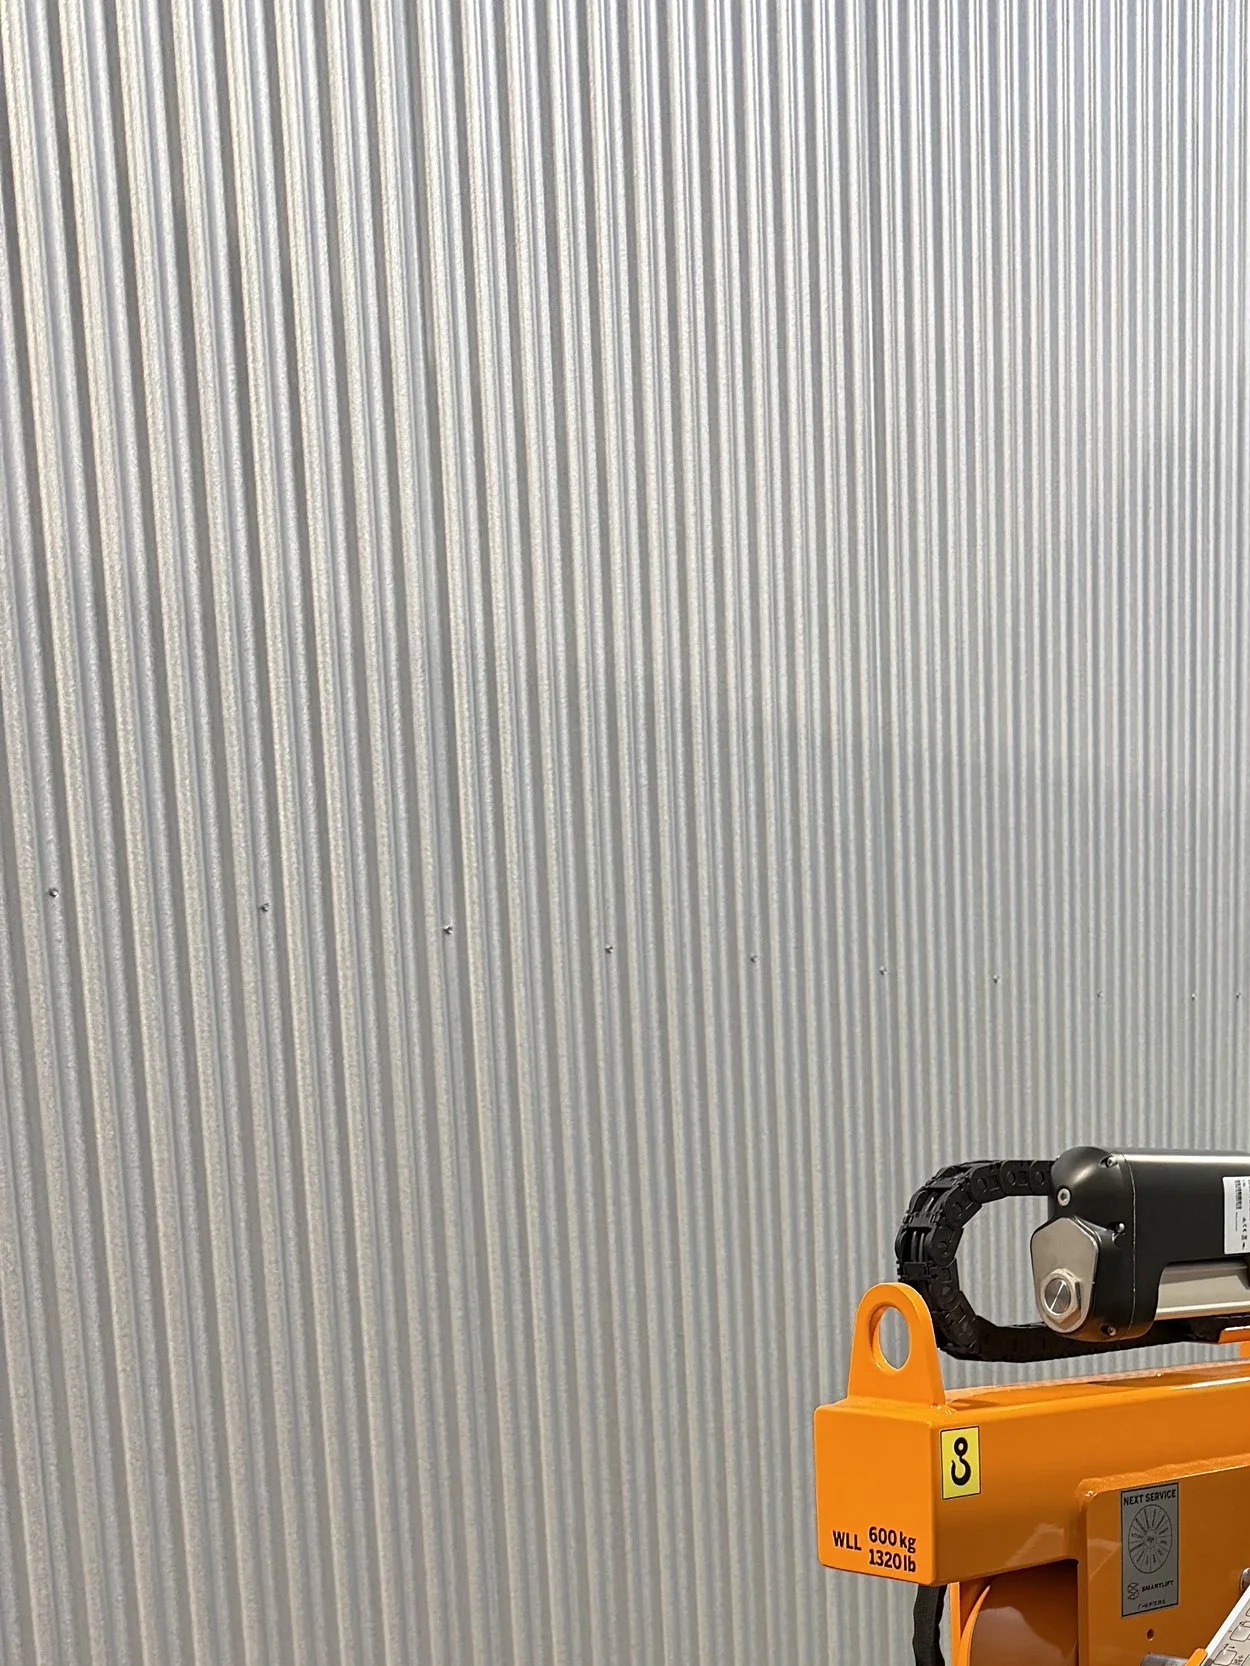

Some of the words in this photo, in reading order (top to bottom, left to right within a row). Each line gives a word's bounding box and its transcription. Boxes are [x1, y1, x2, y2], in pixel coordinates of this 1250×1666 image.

[1123, 1494, 1144, 1506] NEXT
[1145, 1489, 1177, 1502] SERVICE
[832, 1530, 862, 1551] WLL
[868, 1526, 898, 1547] 600
[899, 1531, 917, 1554] kg
[868, 1548, 902, 1570] 1320
[903, 1554, 917, 1573] lb
[1141, 1579, 1174, 1593] SMARTLIFT
